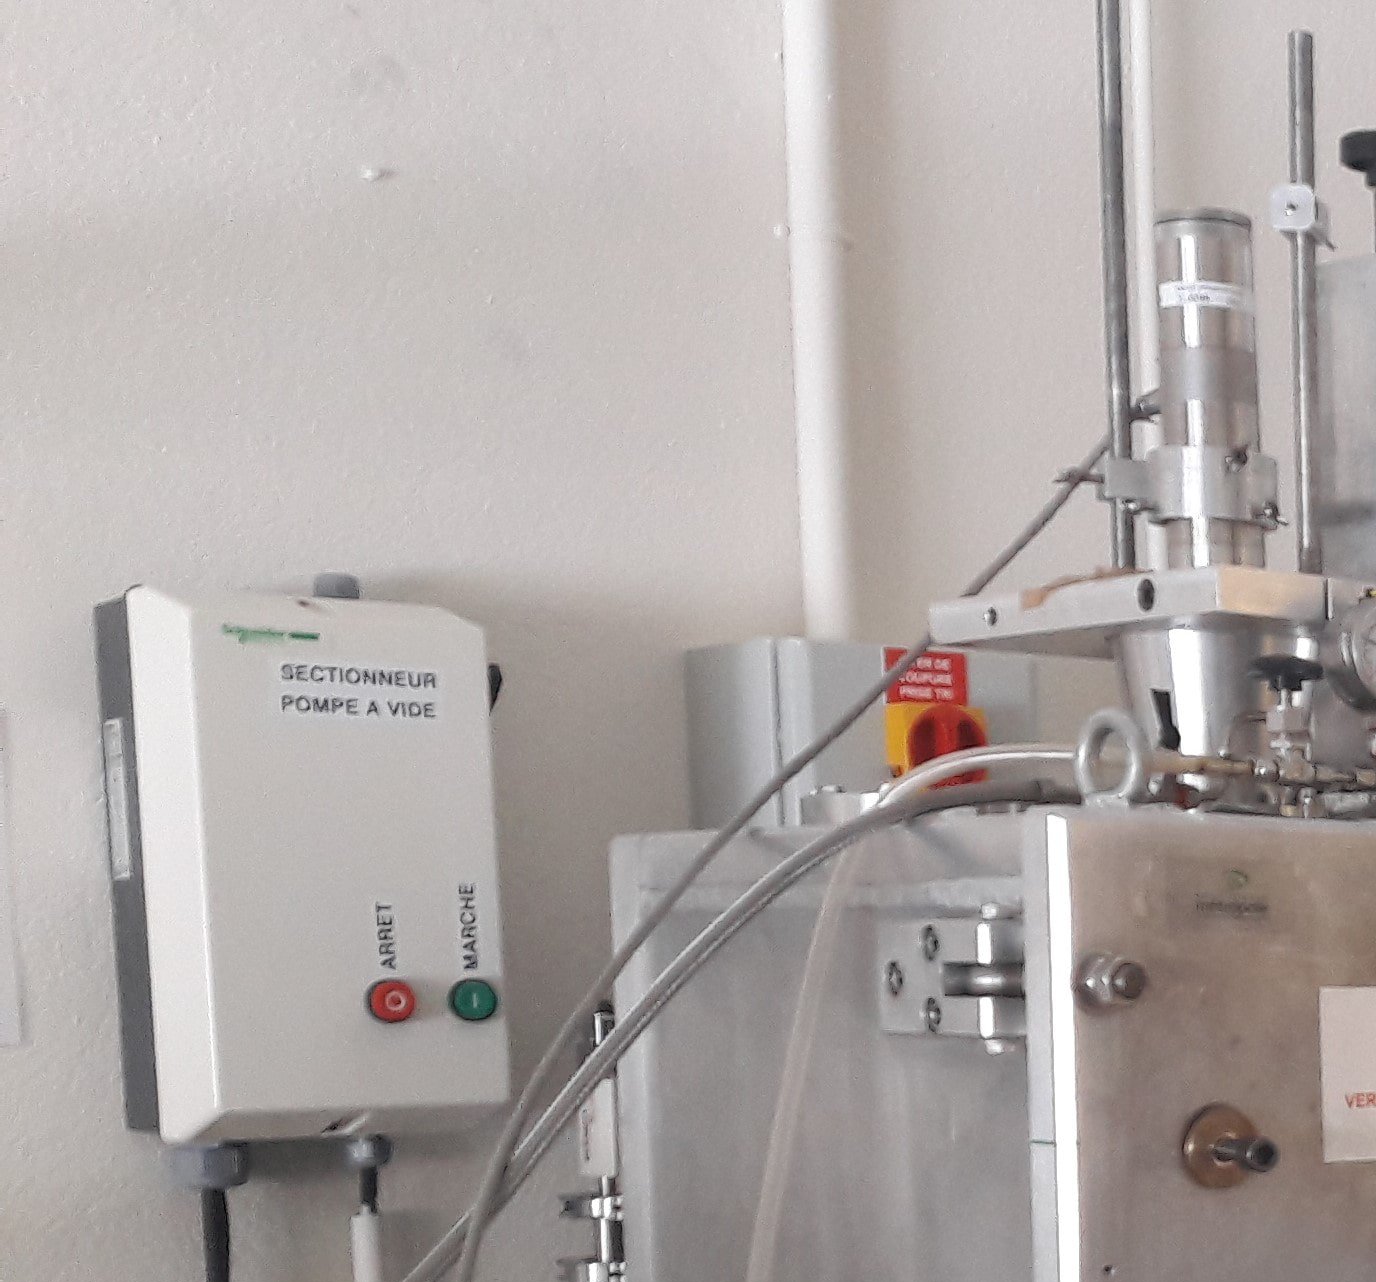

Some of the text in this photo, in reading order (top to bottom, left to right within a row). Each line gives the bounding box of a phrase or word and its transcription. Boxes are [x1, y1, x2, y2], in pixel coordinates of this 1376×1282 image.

[281, 664, 436, 688] SECTIONNEUR
[282, 695, 436, 718] POMPE A VIDE
[376, 902, 396, 969] ARRET
[458, 883, 478, 969] MARCHE
